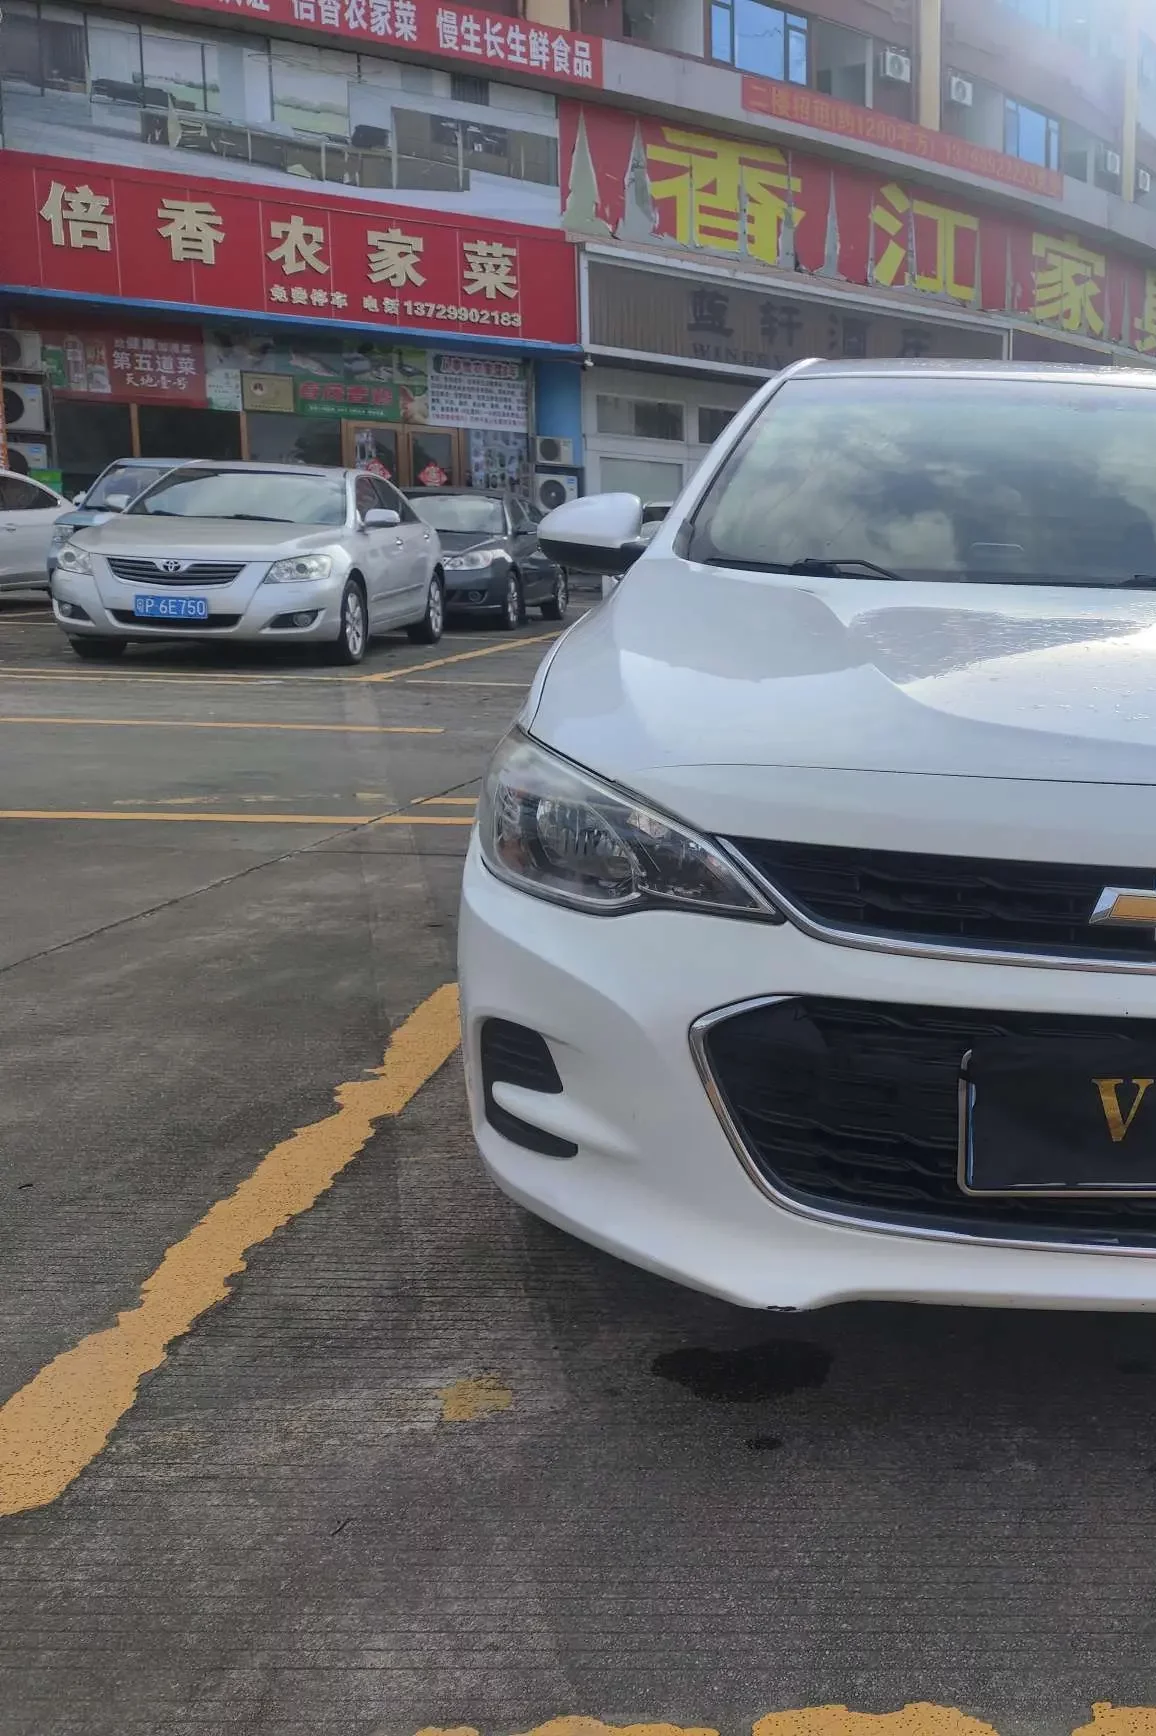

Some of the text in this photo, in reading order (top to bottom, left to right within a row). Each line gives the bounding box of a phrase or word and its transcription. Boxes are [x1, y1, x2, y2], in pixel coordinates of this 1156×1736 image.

[435, 8, 594, 80] 慢生长生鲜食品
[39, 180, 520, 300] 倍香农家菜
[269, 284, 348, 309] 免费停车
[112, 351, 199, 376] 第五道菜
